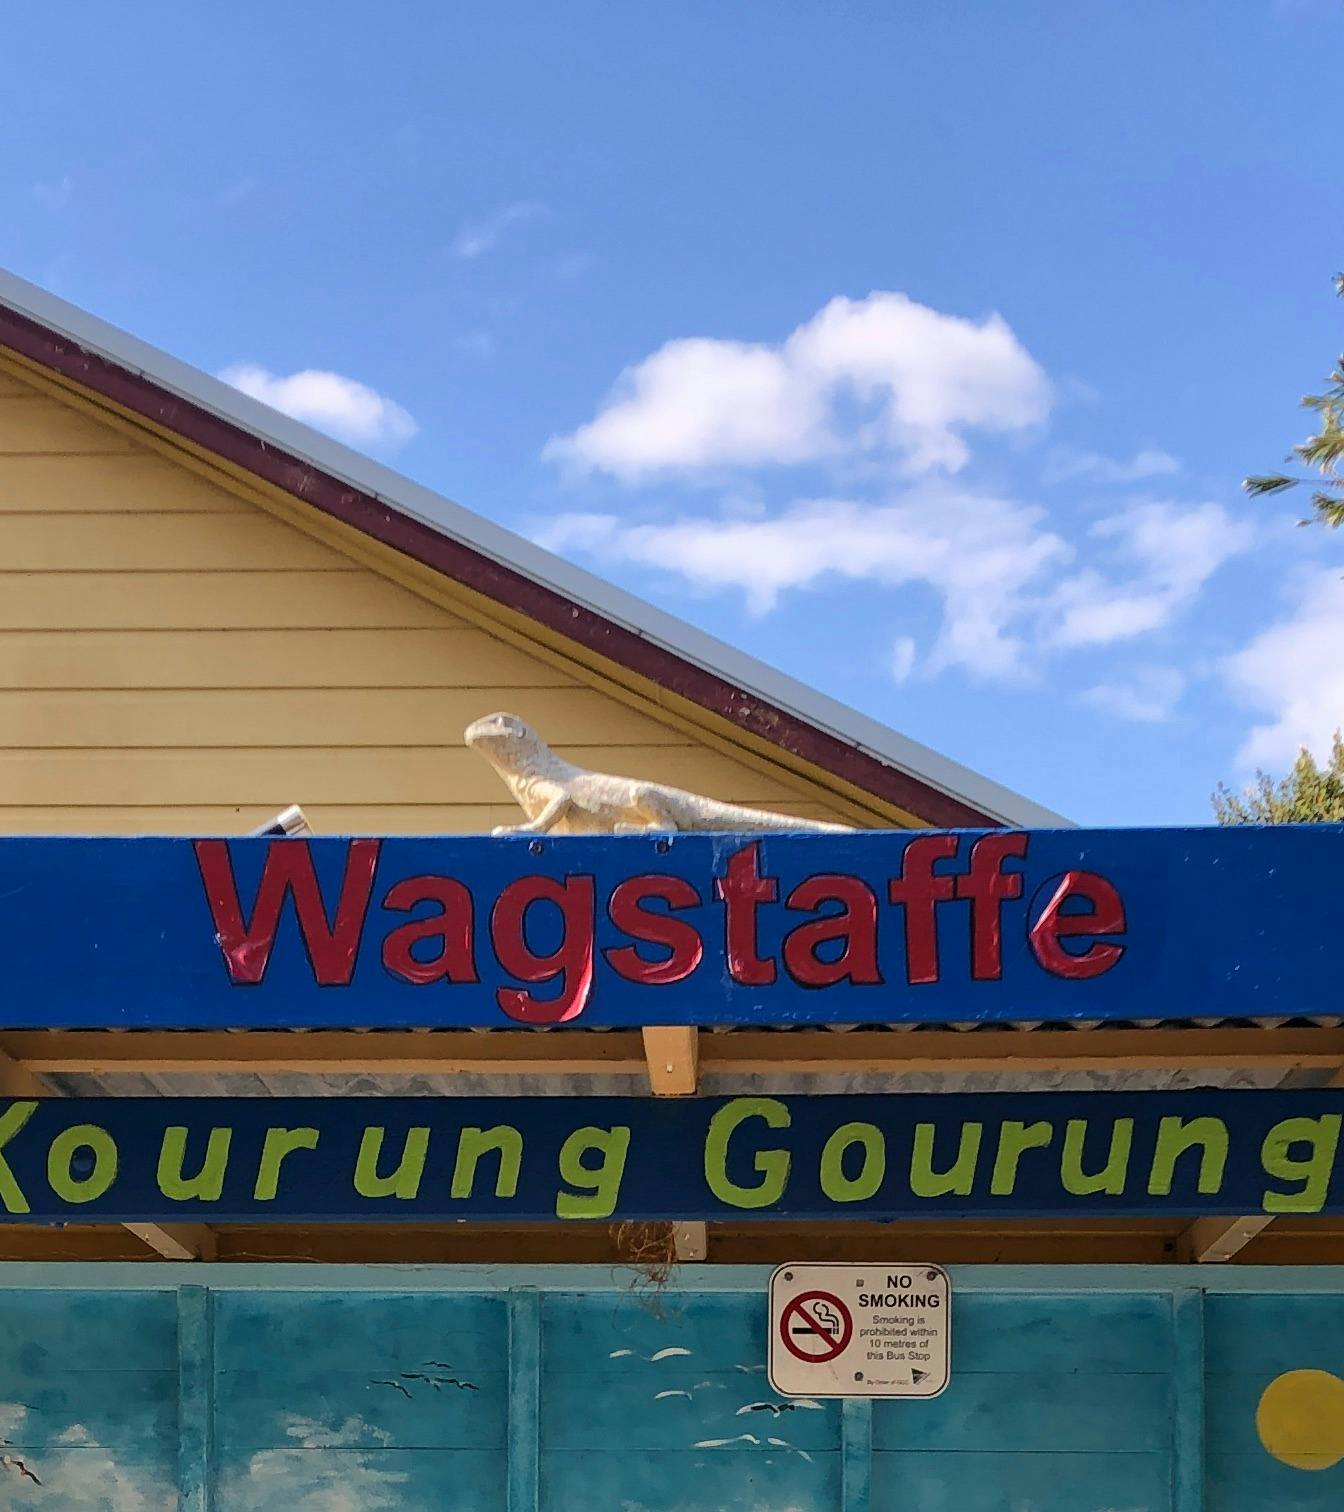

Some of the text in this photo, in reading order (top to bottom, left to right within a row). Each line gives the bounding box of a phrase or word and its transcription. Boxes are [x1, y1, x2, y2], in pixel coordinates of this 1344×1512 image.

[192, 832, 1128, 1026] Wagstaffe
[704, 1097, 1343, 1214] Gourung
[886, 1275, 913, 1289] NO
[858, 1293, 941, 1308] SMOKING
[872, 1315, 926, 1327] Smoking is
[859, 1328, 938, 1338] prohibited within
[869, 1339, 930, 1349] 10 metres of
[866, 1350, 931, 1362] this Bus Stop
